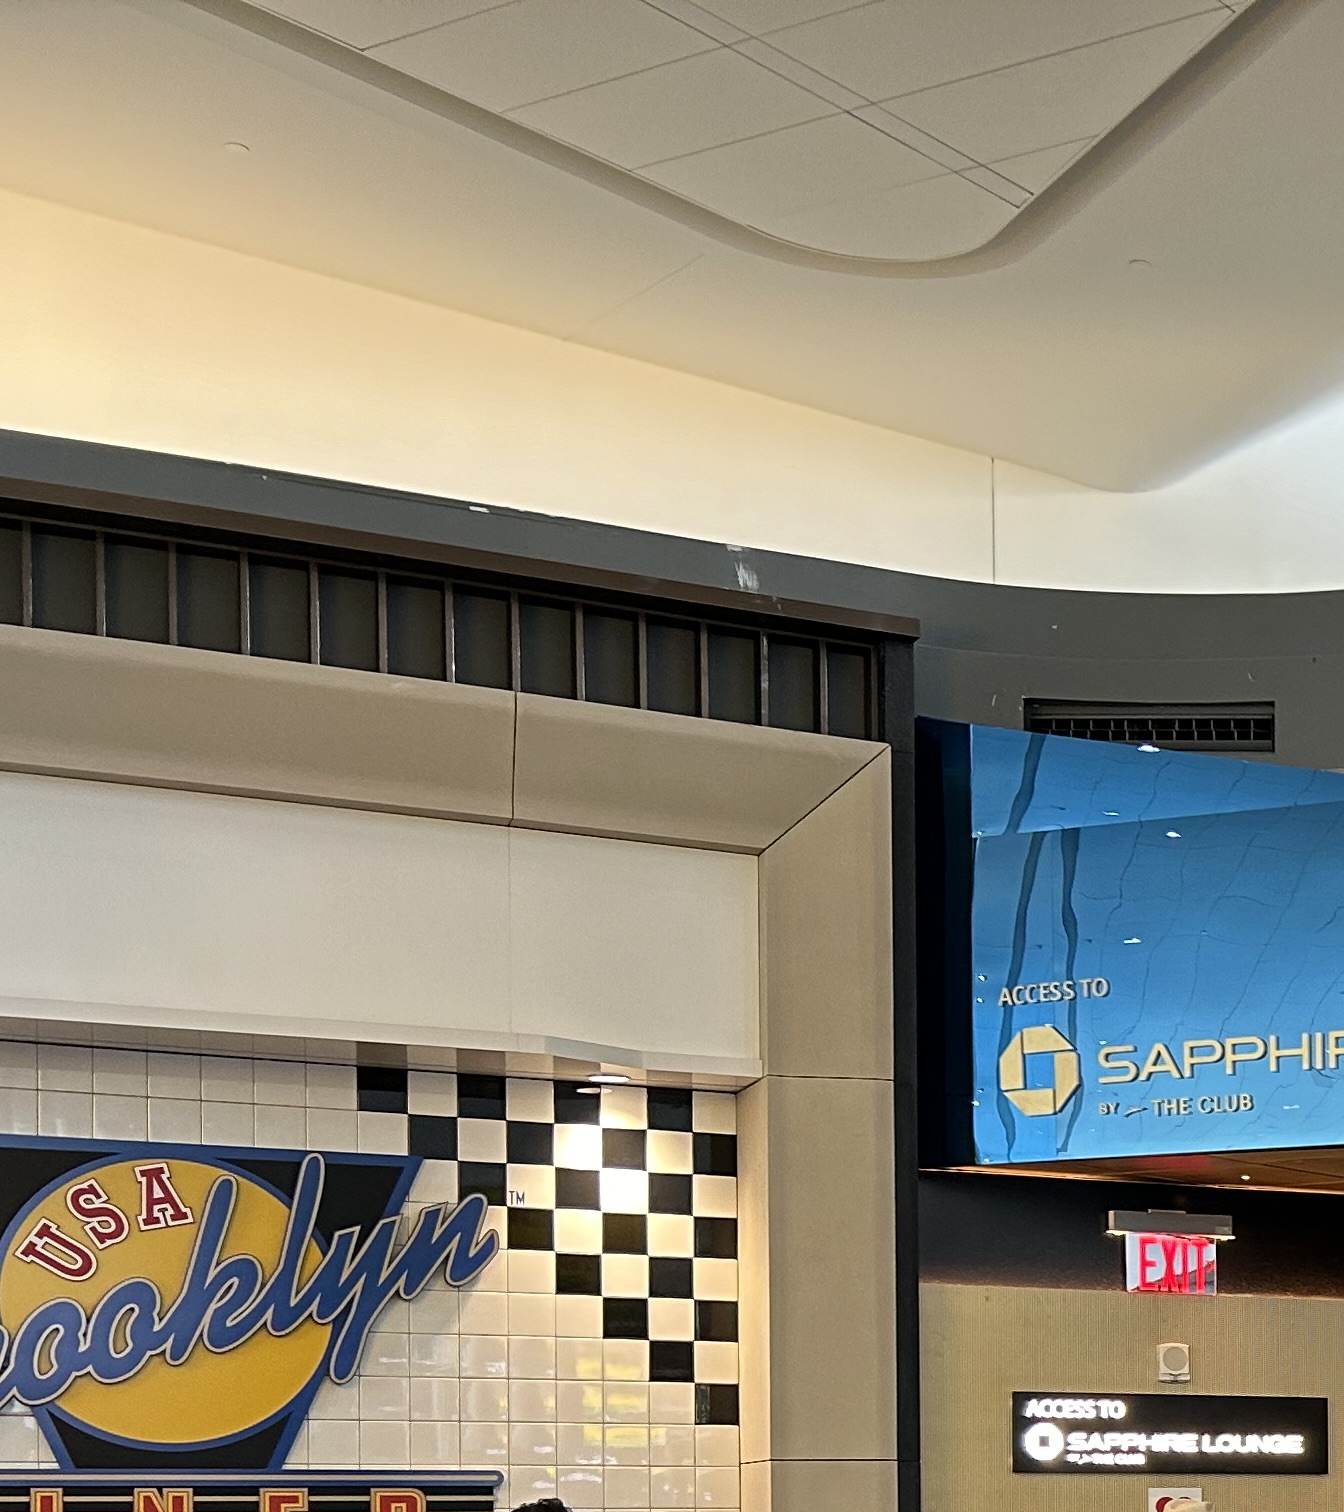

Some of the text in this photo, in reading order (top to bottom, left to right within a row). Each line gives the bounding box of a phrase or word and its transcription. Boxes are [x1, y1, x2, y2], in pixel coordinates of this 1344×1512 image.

[998, 977, 1110, 1007] ACCESS TO
[1100, 1093, 1255, 1116] BY THE CLUB
[14, 1161, 195, 1282] USA
[1139, 1235, 1209, 1293] EXIT
[1024, 1399, 1126, 1420] ACCESS TO
[1066, 1431, 1305, 1455] SAPPHIRE LOUNGE
